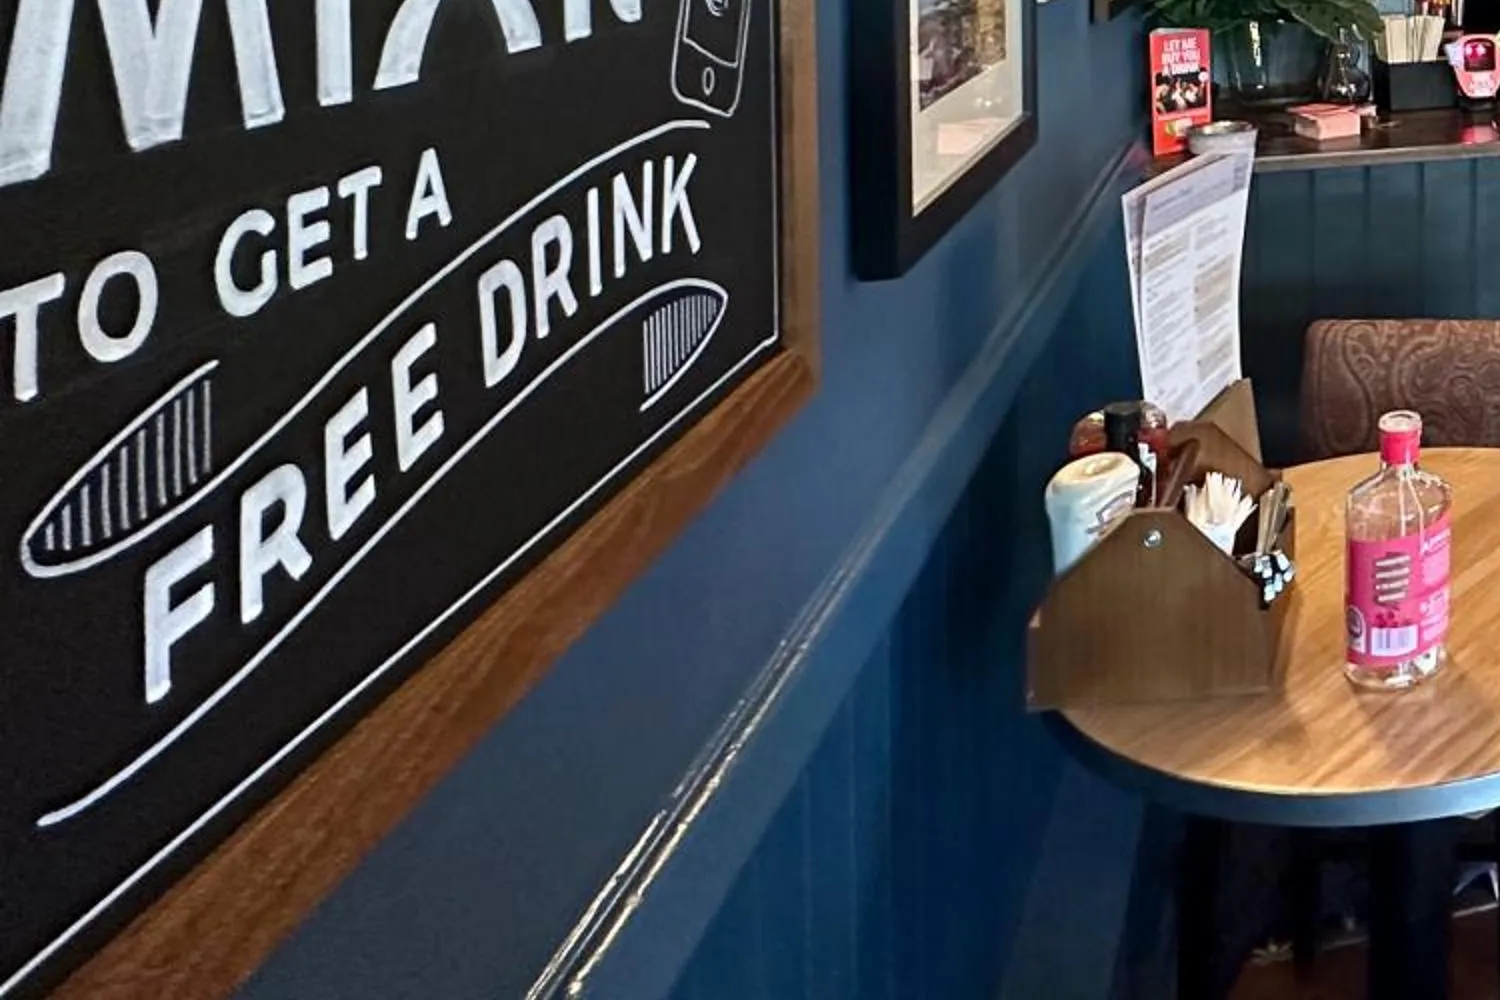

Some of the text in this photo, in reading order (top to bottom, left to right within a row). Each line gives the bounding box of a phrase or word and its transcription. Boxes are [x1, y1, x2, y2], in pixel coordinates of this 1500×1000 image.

[0, 148, 452, 402] TO GET A
[144, 153, 700, 704] FREE DRINK
